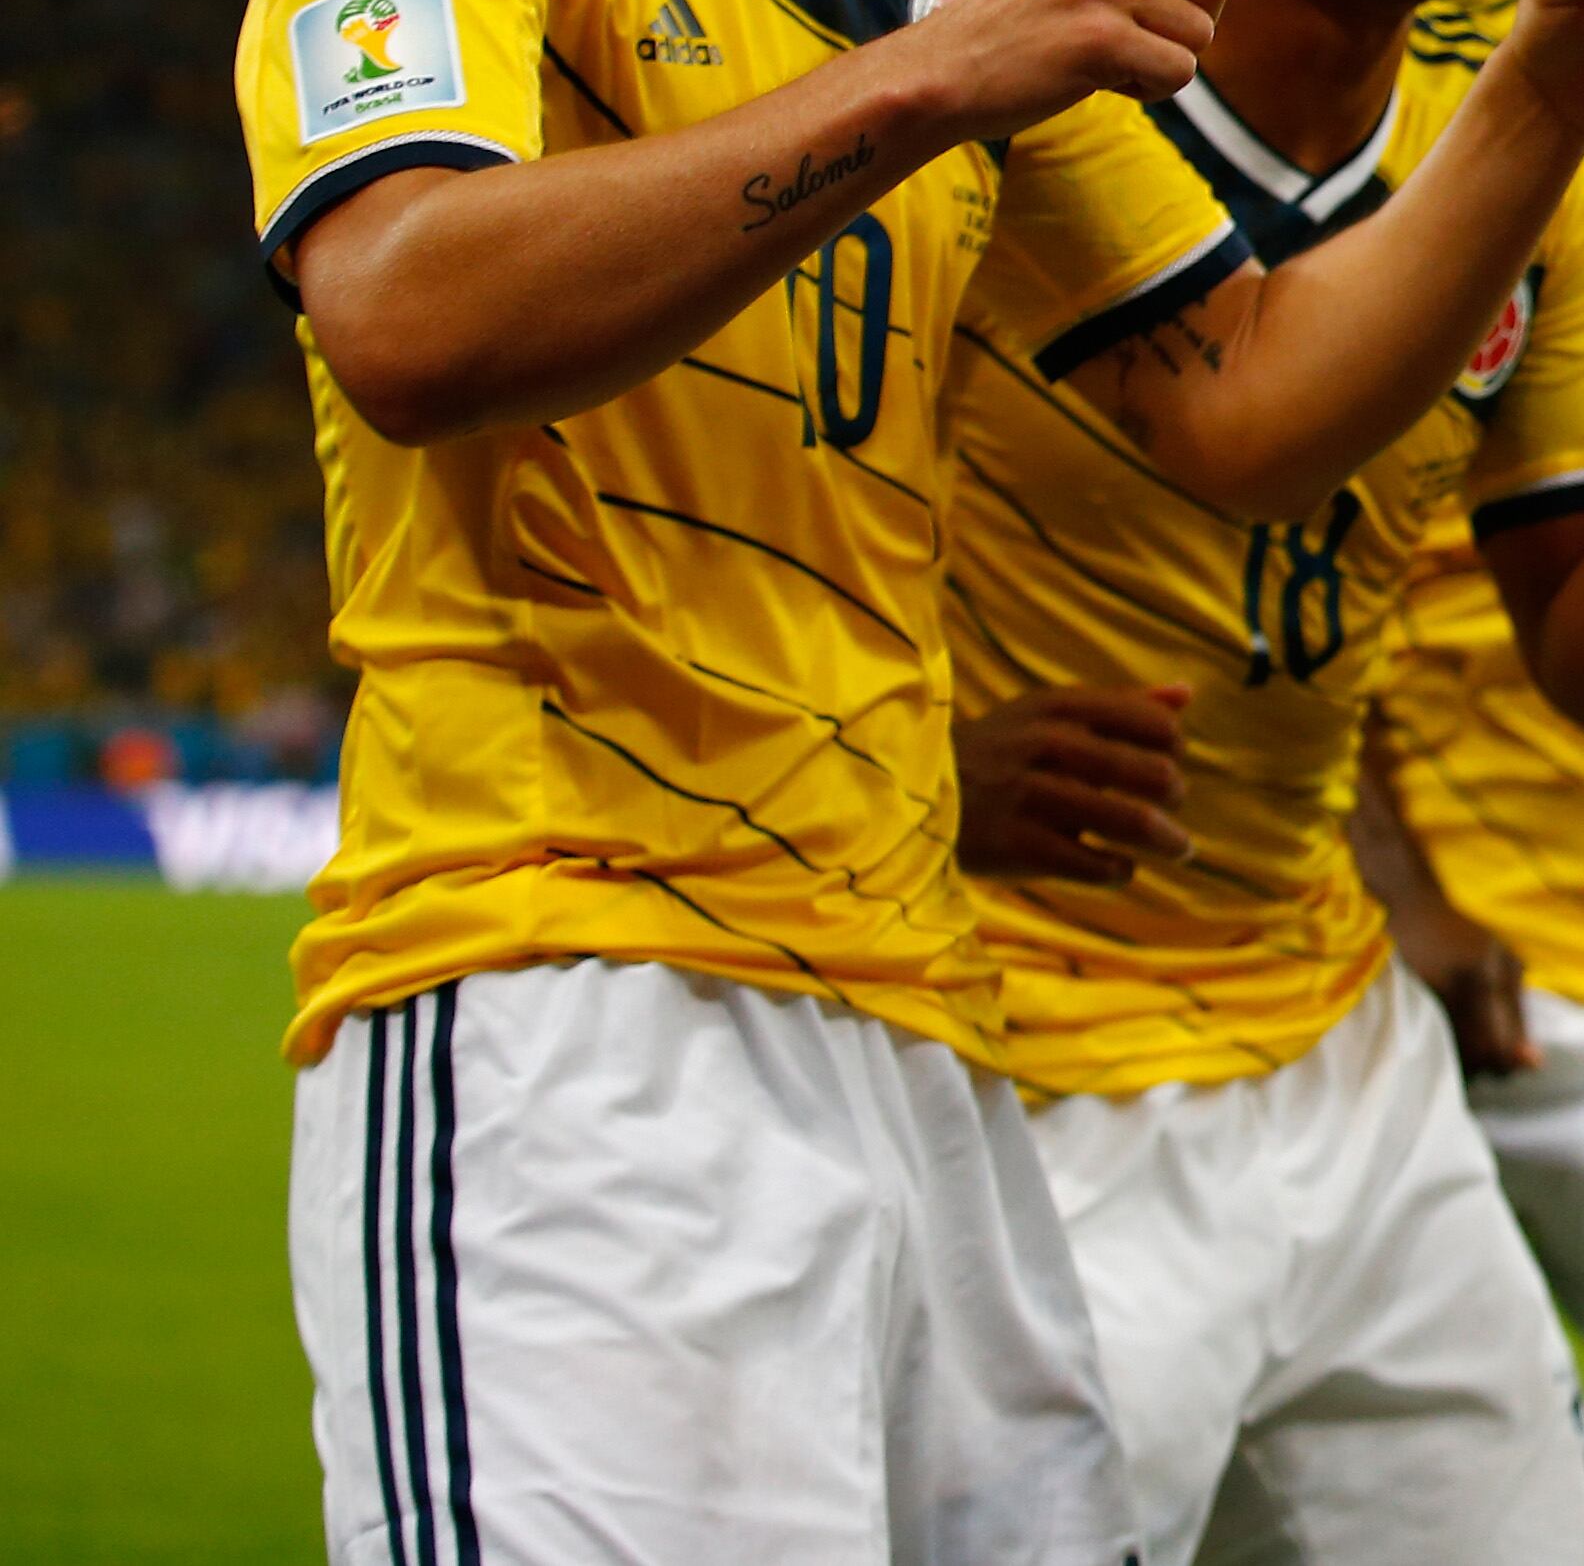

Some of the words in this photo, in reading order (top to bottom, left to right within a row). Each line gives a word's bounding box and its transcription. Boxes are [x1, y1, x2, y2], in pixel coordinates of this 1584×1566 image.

[353, 81, 403, 99] WORLD
[636, 36, 724, 66] adidas
[786, 211, 893, 448] 0
[1244, 489, 1362, 688] 18
